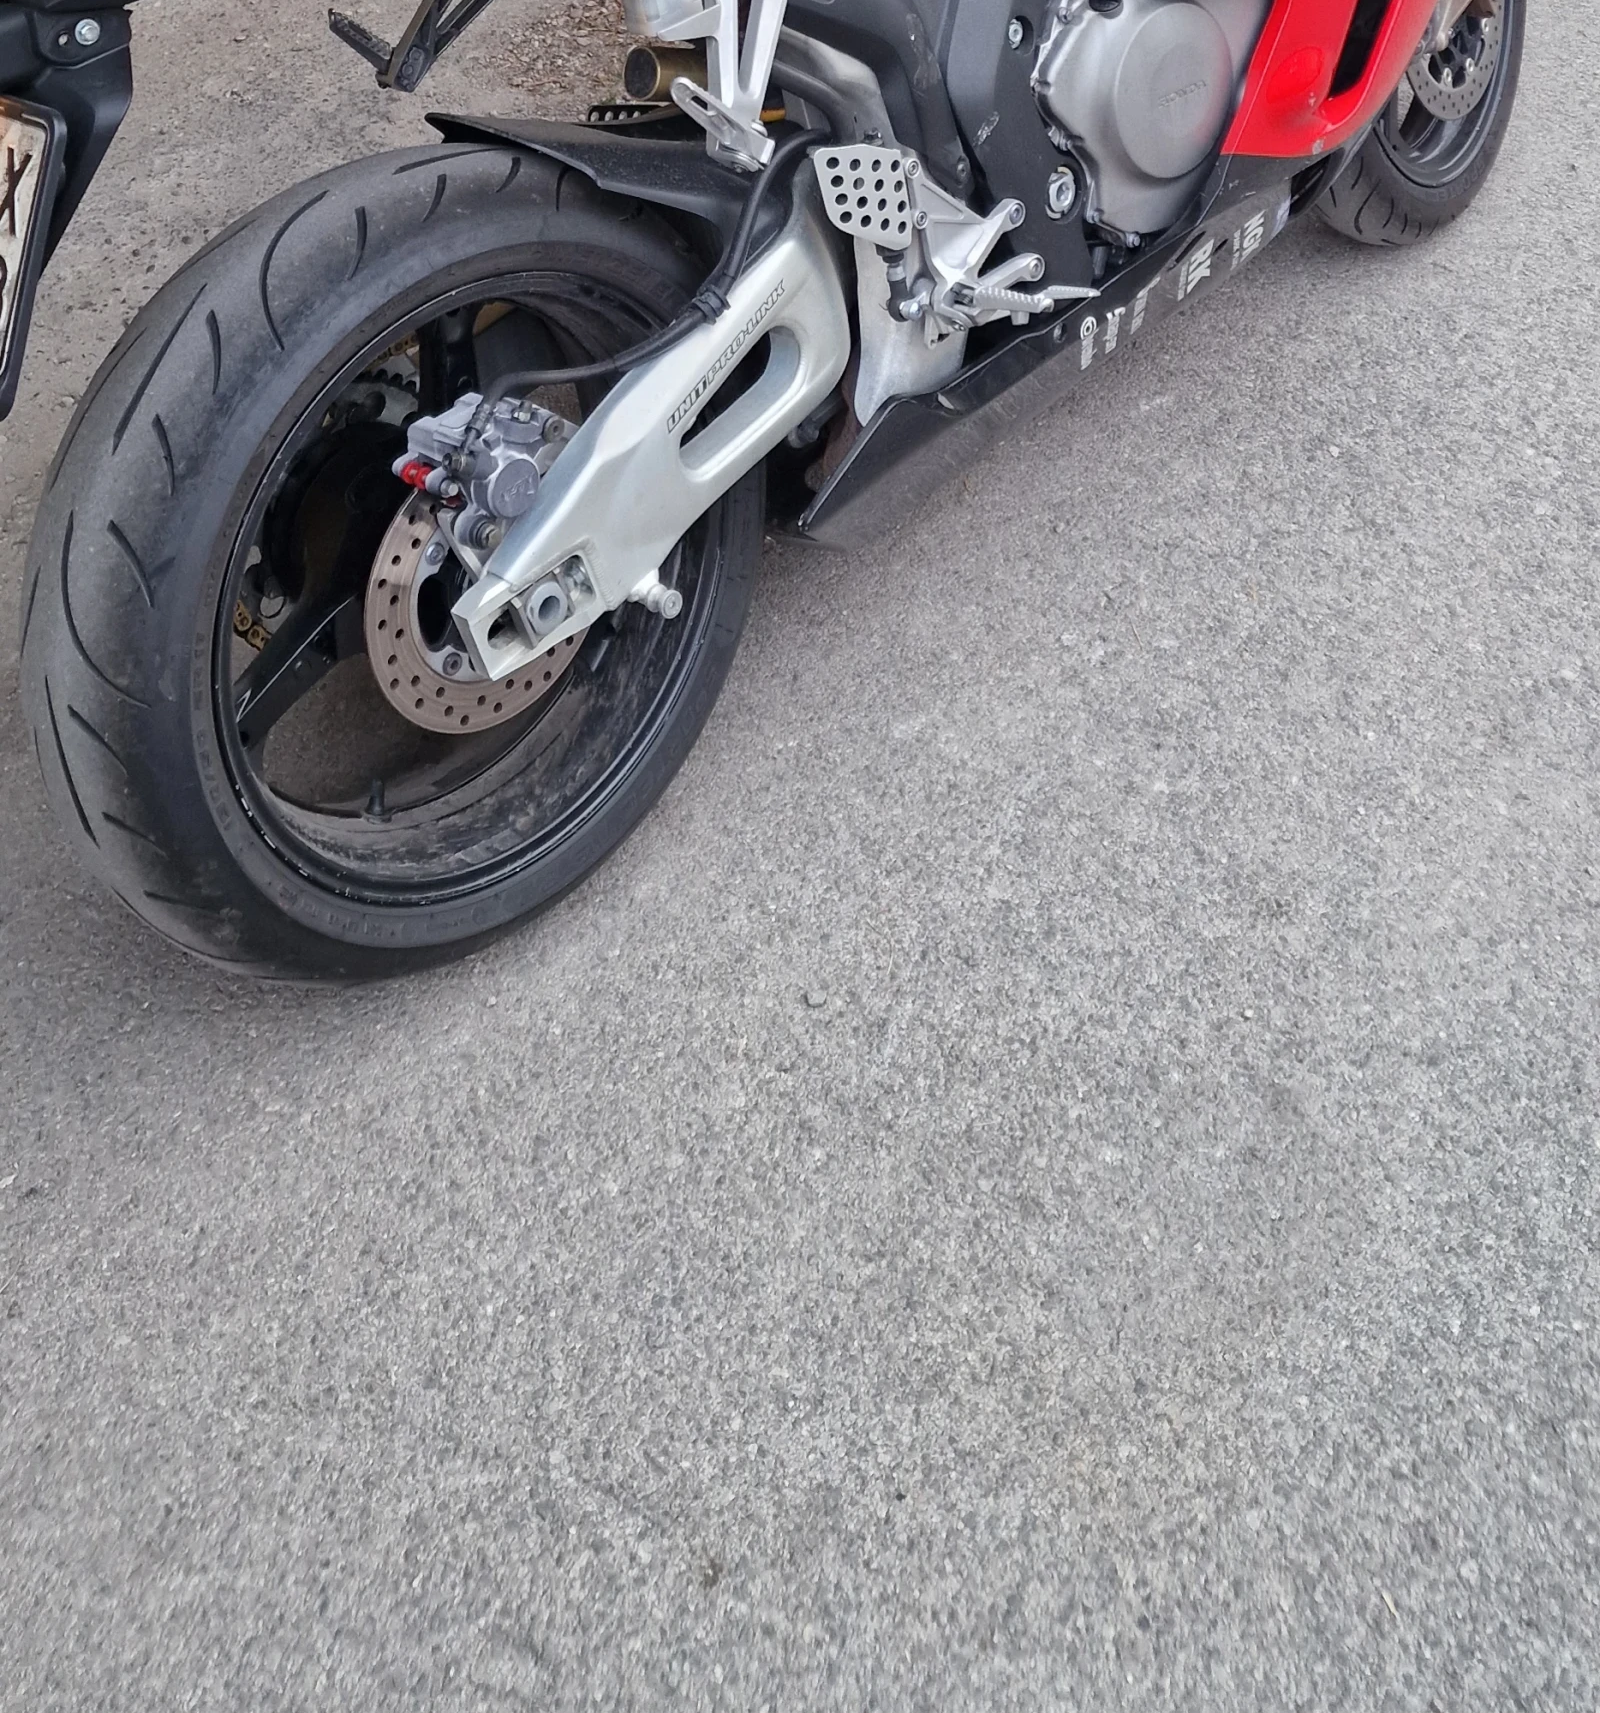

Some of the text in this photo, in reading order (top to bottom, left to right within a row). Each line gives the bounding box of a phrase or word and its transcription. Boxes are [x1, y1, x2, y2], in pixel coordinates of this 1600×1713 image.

[1240, 208, 1267, 263] NGK
[1186, 238, 1215, 295] RK
[667, 278, 786, 434] UNIT PRO-LINK
